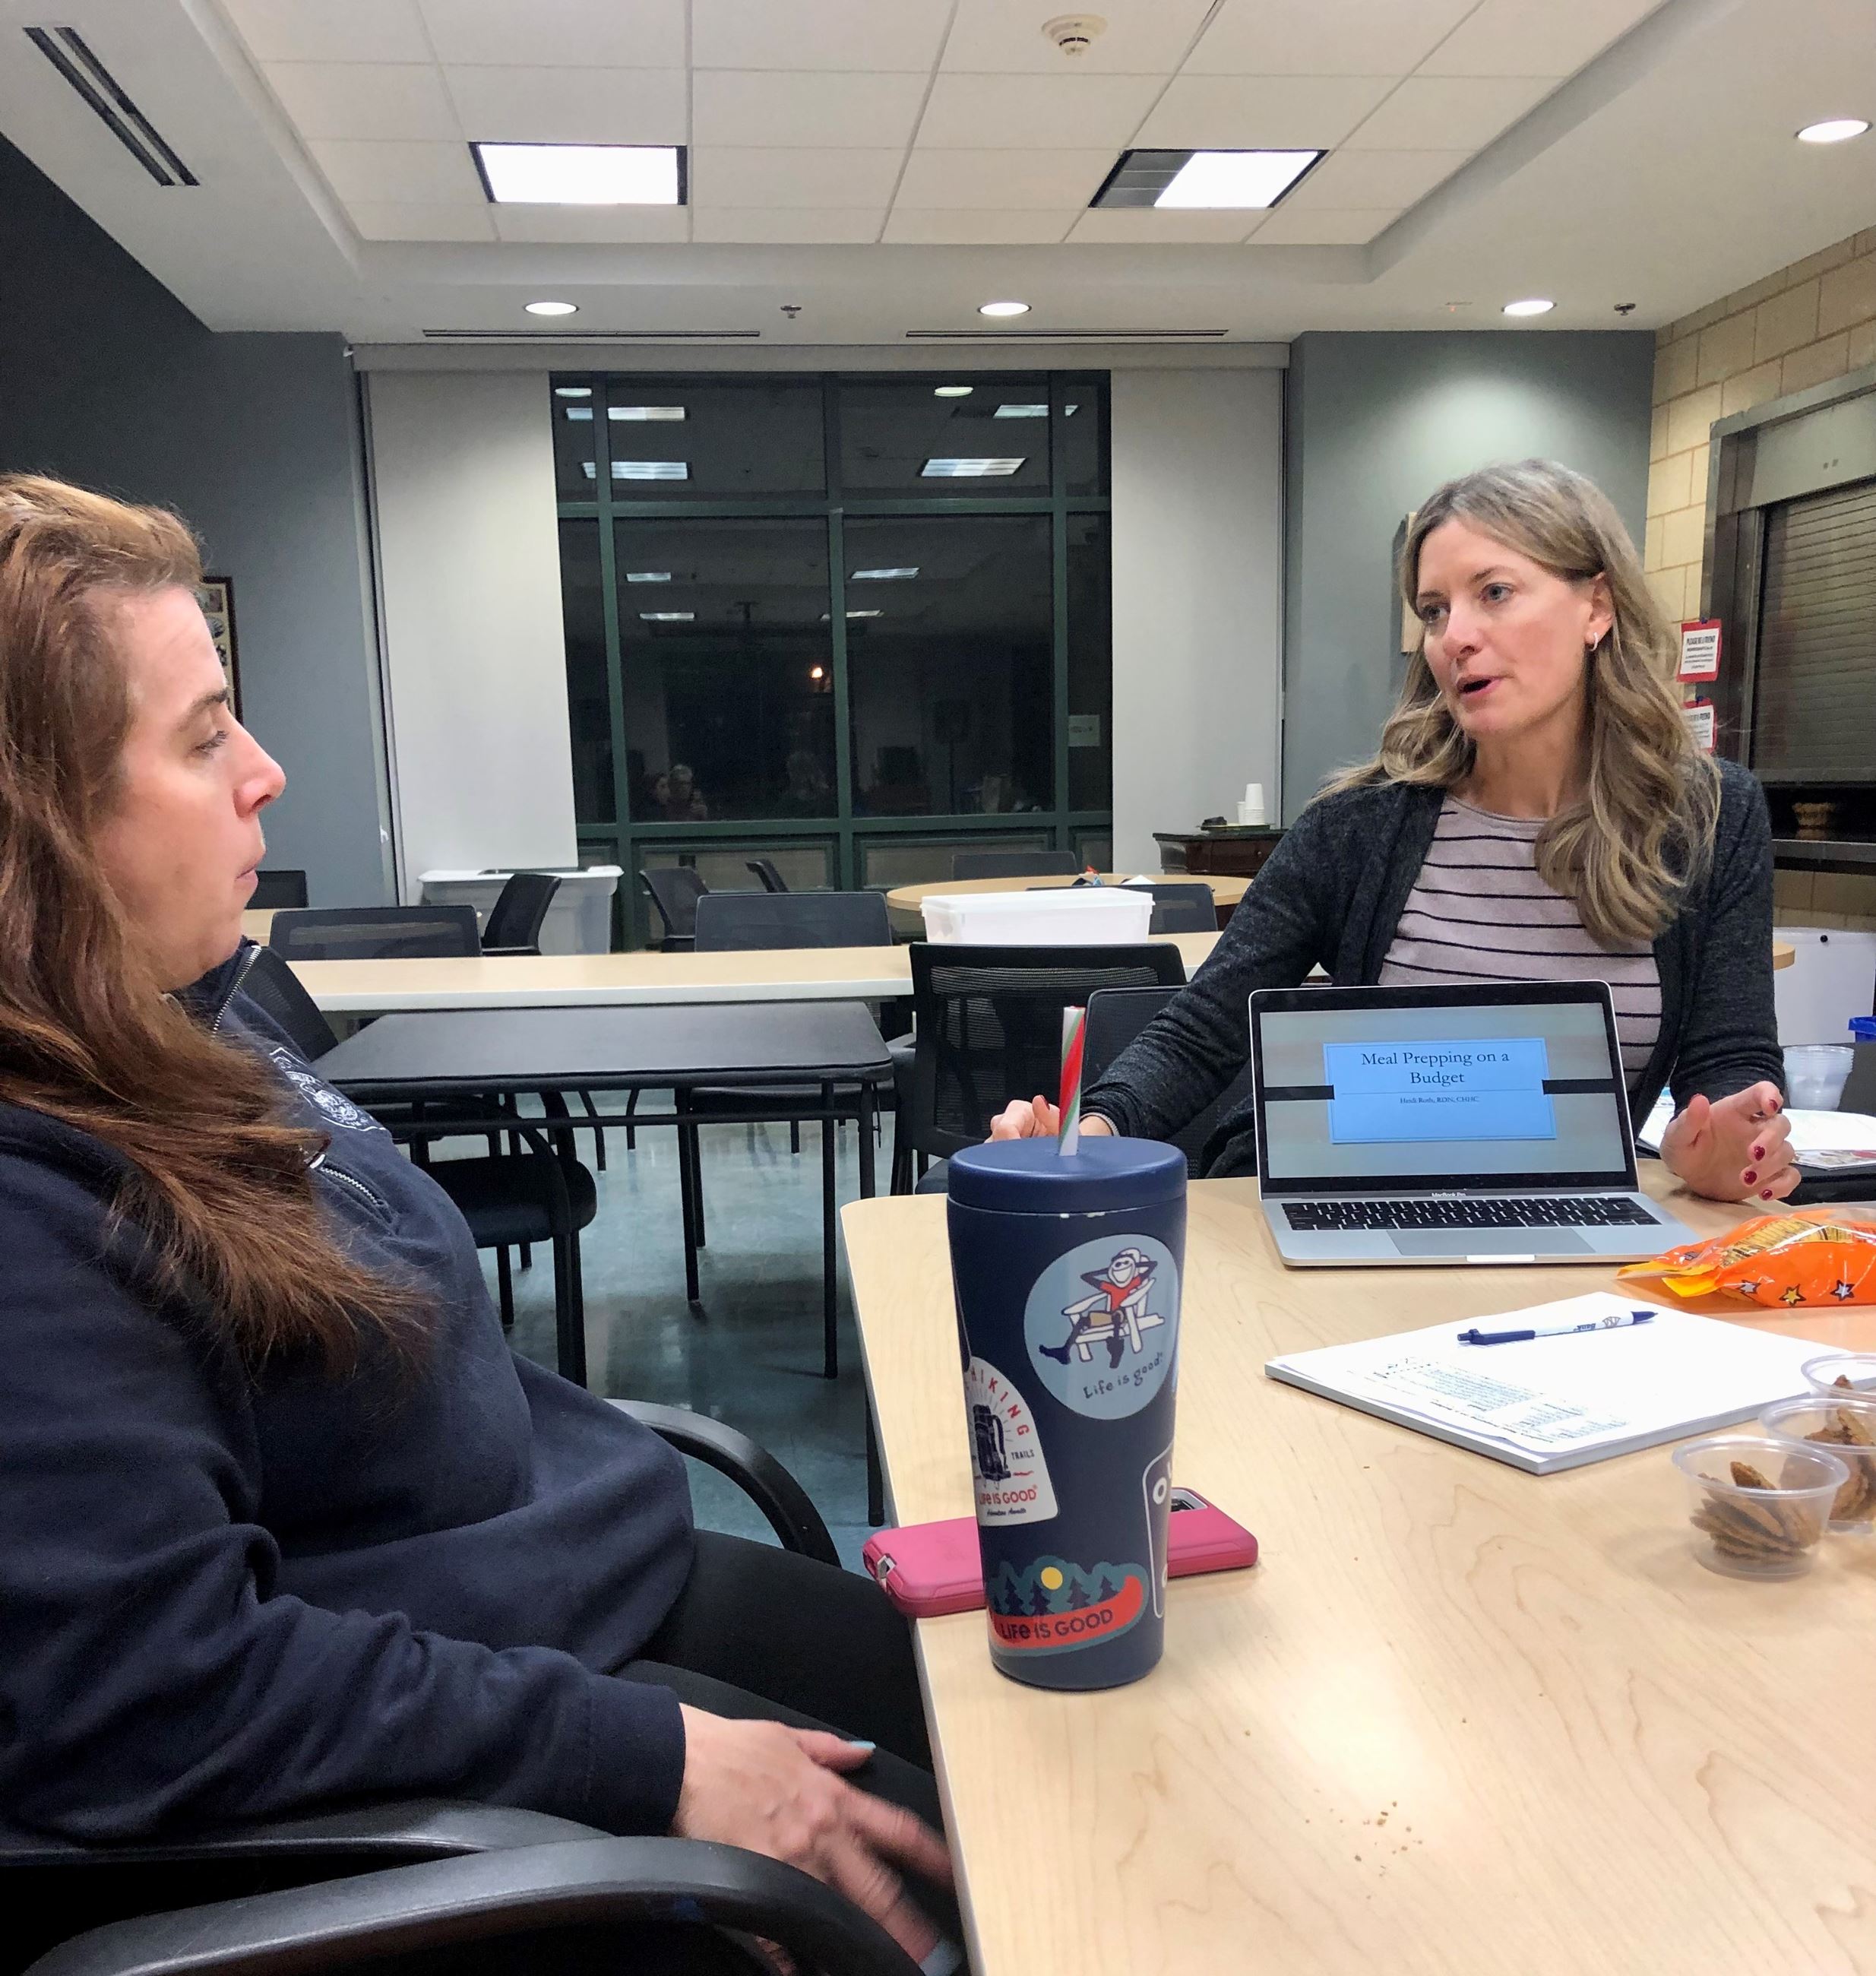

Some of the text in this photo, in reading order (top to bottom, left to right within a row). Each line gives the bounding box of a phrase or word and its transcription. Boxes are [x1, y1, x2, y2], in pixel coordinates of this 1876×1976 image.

[1361, 1051, 1510, 1067] Meal Prepping on a
[1410, 1072, 1465, 1087] Budget
[1084, 1379, 1113, 1398] Life
[1118, 1375, 1130, 1385] is
[1011, 1449, 1035, 1460] TRAILS
[992, 1493, 1001, 1505] IS
[1033, 1623, 1051, 1639] IS
[1055, 1609, 1113, 1636] GOOD
